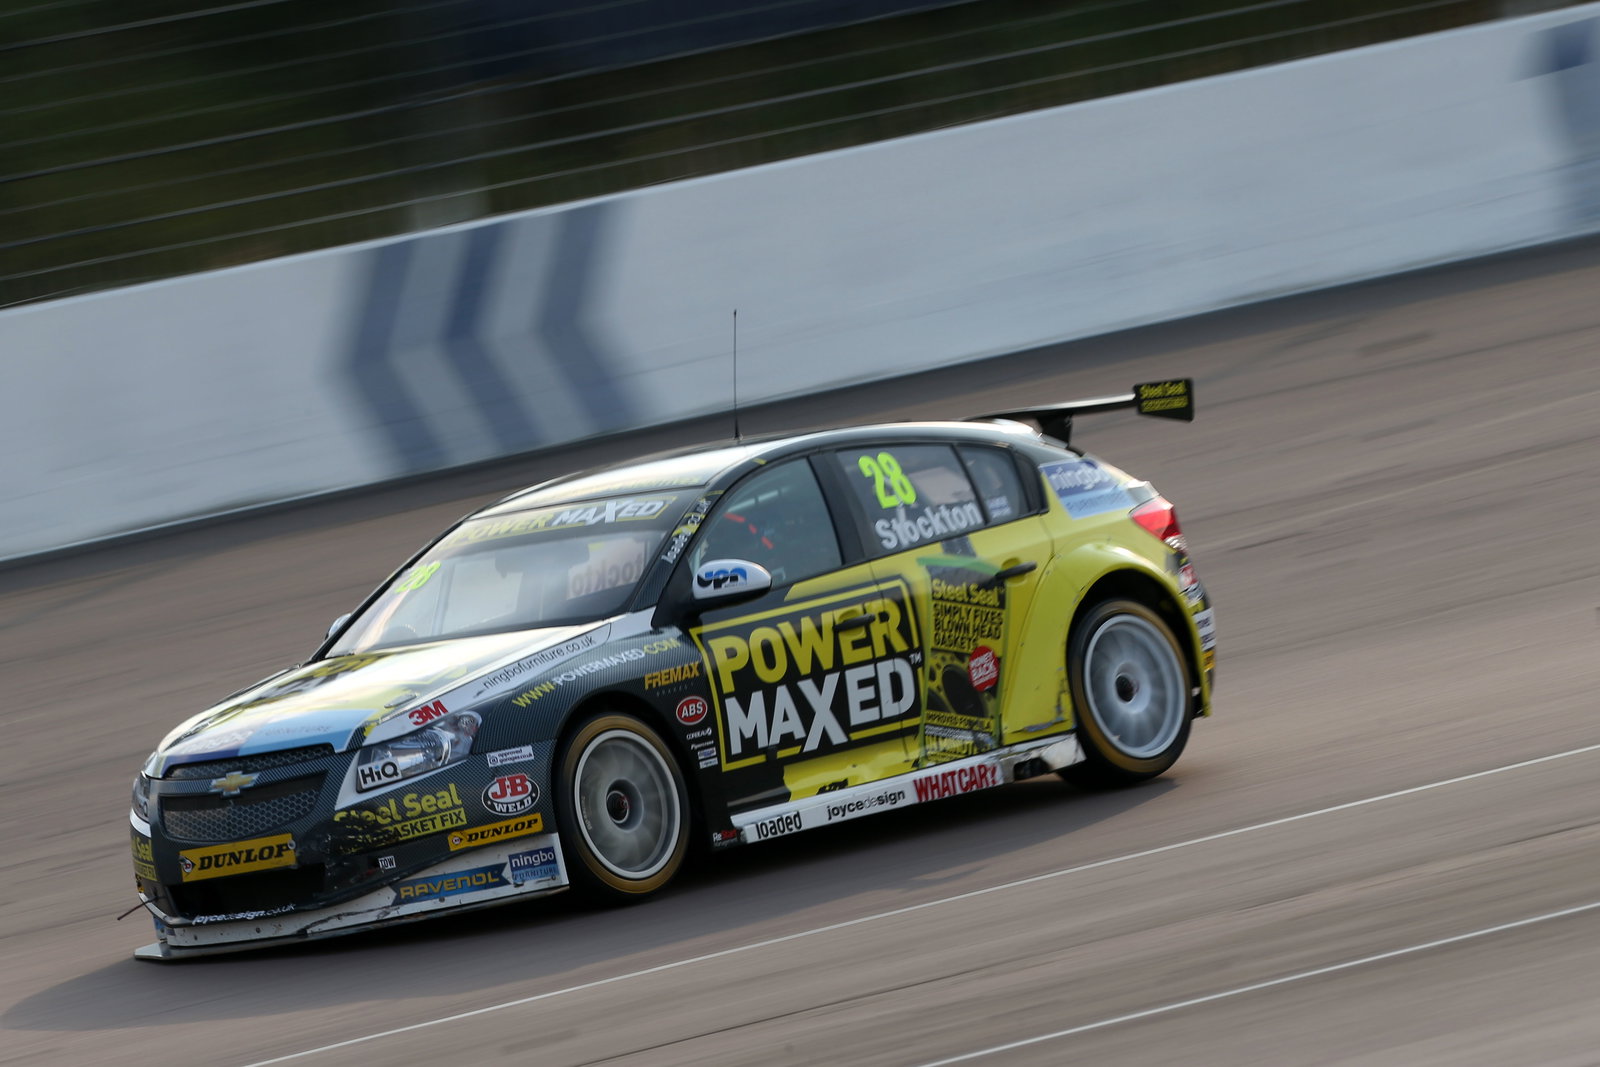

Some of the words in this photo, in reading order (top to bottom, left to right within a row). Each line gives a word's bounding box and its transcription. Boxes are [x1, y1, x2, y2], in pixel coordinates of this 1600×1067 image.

[858, 451, 917, 509] 28
[551, 500, 665, 527] MAXED
[874, 501, 984, 550] Stockton
[933, 603, 972, 621] SIMPLY
[707, 598, 910, 695] POWER
[483, 635, 597, 690] ningbofurniture.co.uk
[644, 661, 700, 690] FREMAX
[408, 700, 449, 726] 3M
[681, 701, 704, 718] ABS
[724, 658, 916, 756] MAXED
[360, 761, 400, 785] HiQ
[402, 783, 463, 817] Seal
[493, 799, 533, 814] WELD
[440, 811, 466, 827] FIX
[466, 818, 539, 842] DUNLOP
[755, 811, 803, 839] loaded
[197, 842, 291, 871] DUNLOP
[380, 857, 396, 868] TOW
[511, 850, 555, 868] ningbo
[400, 871, 500, 899] RAVENOL
